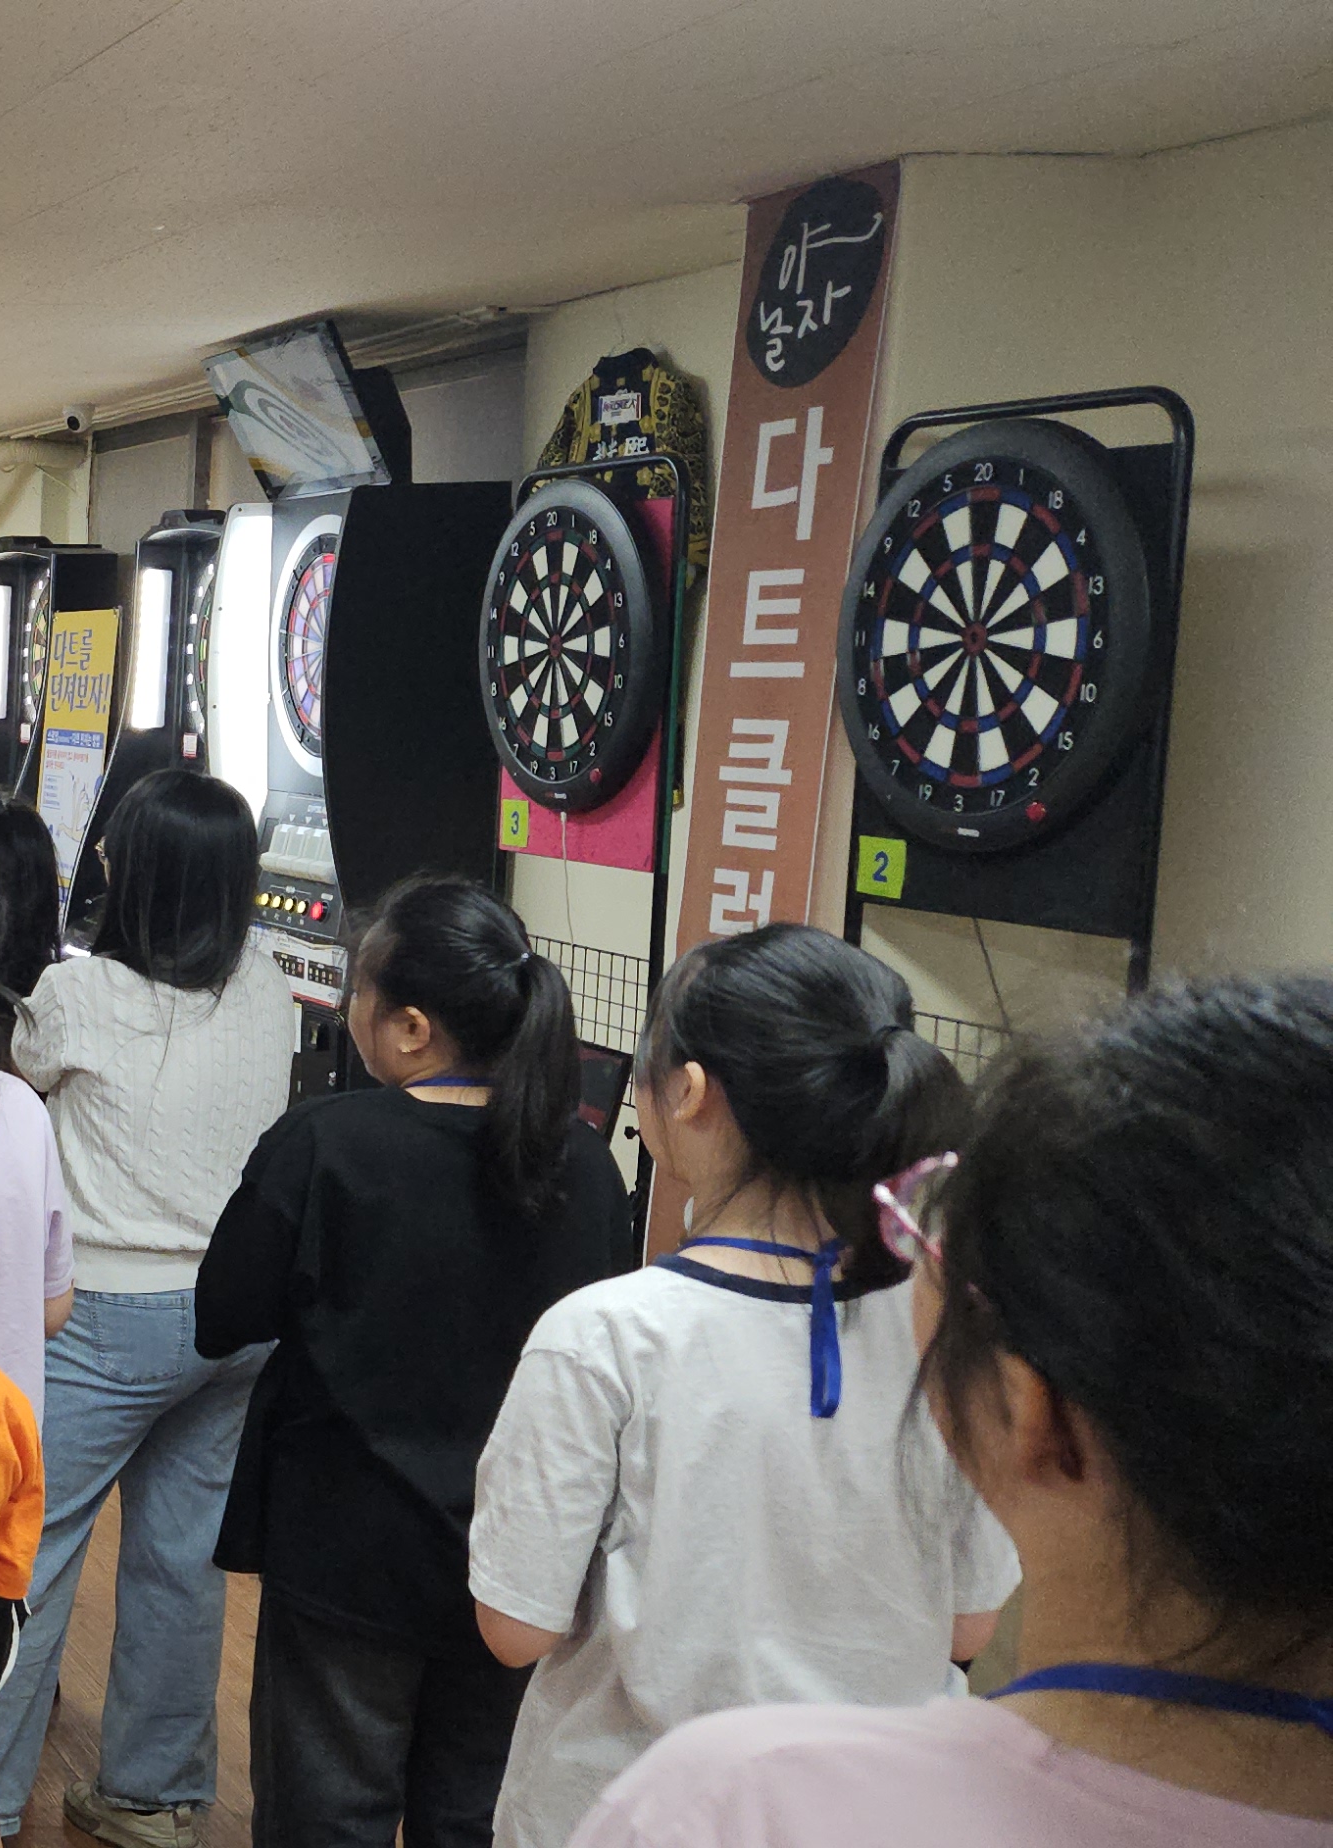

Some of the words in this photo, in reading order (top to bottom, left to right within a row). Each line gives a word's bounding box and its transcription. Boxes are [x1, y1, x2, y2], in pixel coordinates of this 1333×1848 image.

[759, 280, 852, 372] 놀자
[973, 462, 994, 483] 20
[943, 474, 953, 493] 5
[1048, 490, 1064, 510] 18
[546, 511, 558, 526] 20
[907, 500, 922, 519] 12
[529, 521, 536, 536] 5
[589, 529, 598, 545] 18
[1076, 529, 1087, 546] 4
[511, 541, 519, 557] 12
[883, 536, 893, 554] 9
[605, 558, 612, 571] 4
[498, 571, 506, 586] 9
[1088, 575, 1104, 596] 13
[863, 580, 876, 599] 14
[614, 592, 623, 608] 13
[490, 607, 498, 621] 14
[618, 634, 625, 648] 6
[854, 630, 866, 648] 11
[1093, 631, 1104, 649] 6
[53, 628, 93, 671] 다트를
[487, 645, 495, 659] 11
[491, 682, 498, 697] 8
[614, 674, 623, 689] 10
[857, 678, 867, 696] 8
[50, 672, 111, 714] 던져보자!
[1080, 683, 1097, 703] 10
[498, 716, 507, 731] 16
[604, 712, 613, 727] 15
[867, 723, 880, 741] 16
[1058, 731, 1074, 751] 15
[512, 743, 519, 757] 7
[589, 741, 596, 757] 2
[530, 760, 539, 774] 19
[549, 766, 556, 781] 3
[569, 760, 578, 775] 17
[890, 759, 901, 777] 7
[1028, 767, 1039, 787] 2
[918, 784, 933, 802] 19
[989, 789, 1006, 808] 17
[953, 794, 964, 813] 3
[510, 811, 520, 835] 3
[872, 851, 889, 883] 2
